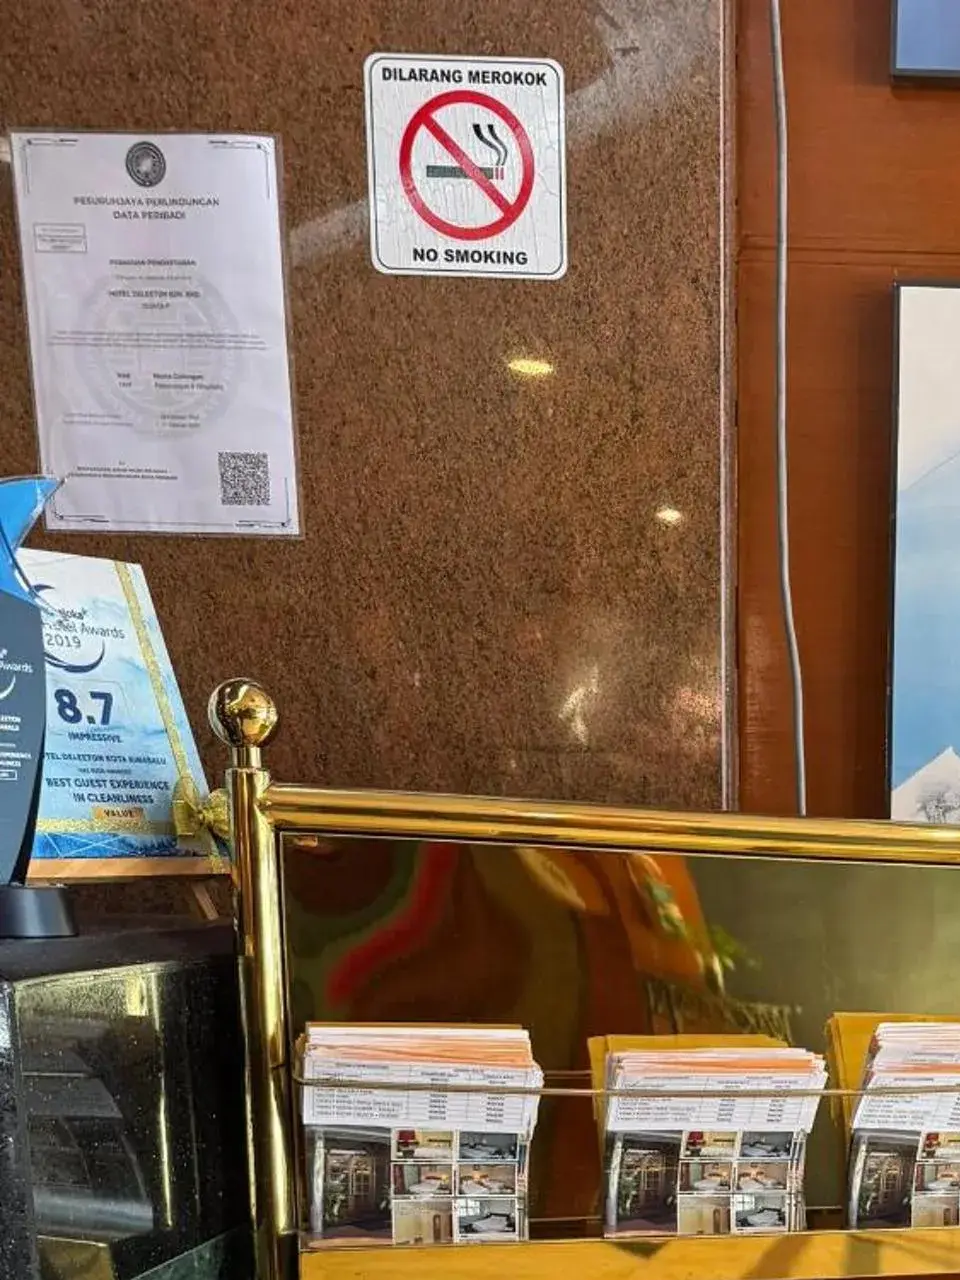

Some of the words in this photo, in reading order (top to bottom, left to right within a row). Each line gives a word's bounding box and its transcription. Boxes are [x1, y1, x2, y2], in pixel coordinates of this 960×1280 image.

[382, 68, 463, 83] DILARANG
[468, 70, 547, 86] MEROKOK
[113, 210, 139, 219] DATA
[413, 248, 438, 262] NO
[444, 249, 528, 265] SMOKING
[81, 622, 125, 639] Awards
[45, 633, 81, 648] 2019
[54, 688, 113, 725] 8.7
[74, 778, 107, 789] GUEST
[109, 779, 170, 791] EXPERIENCE
